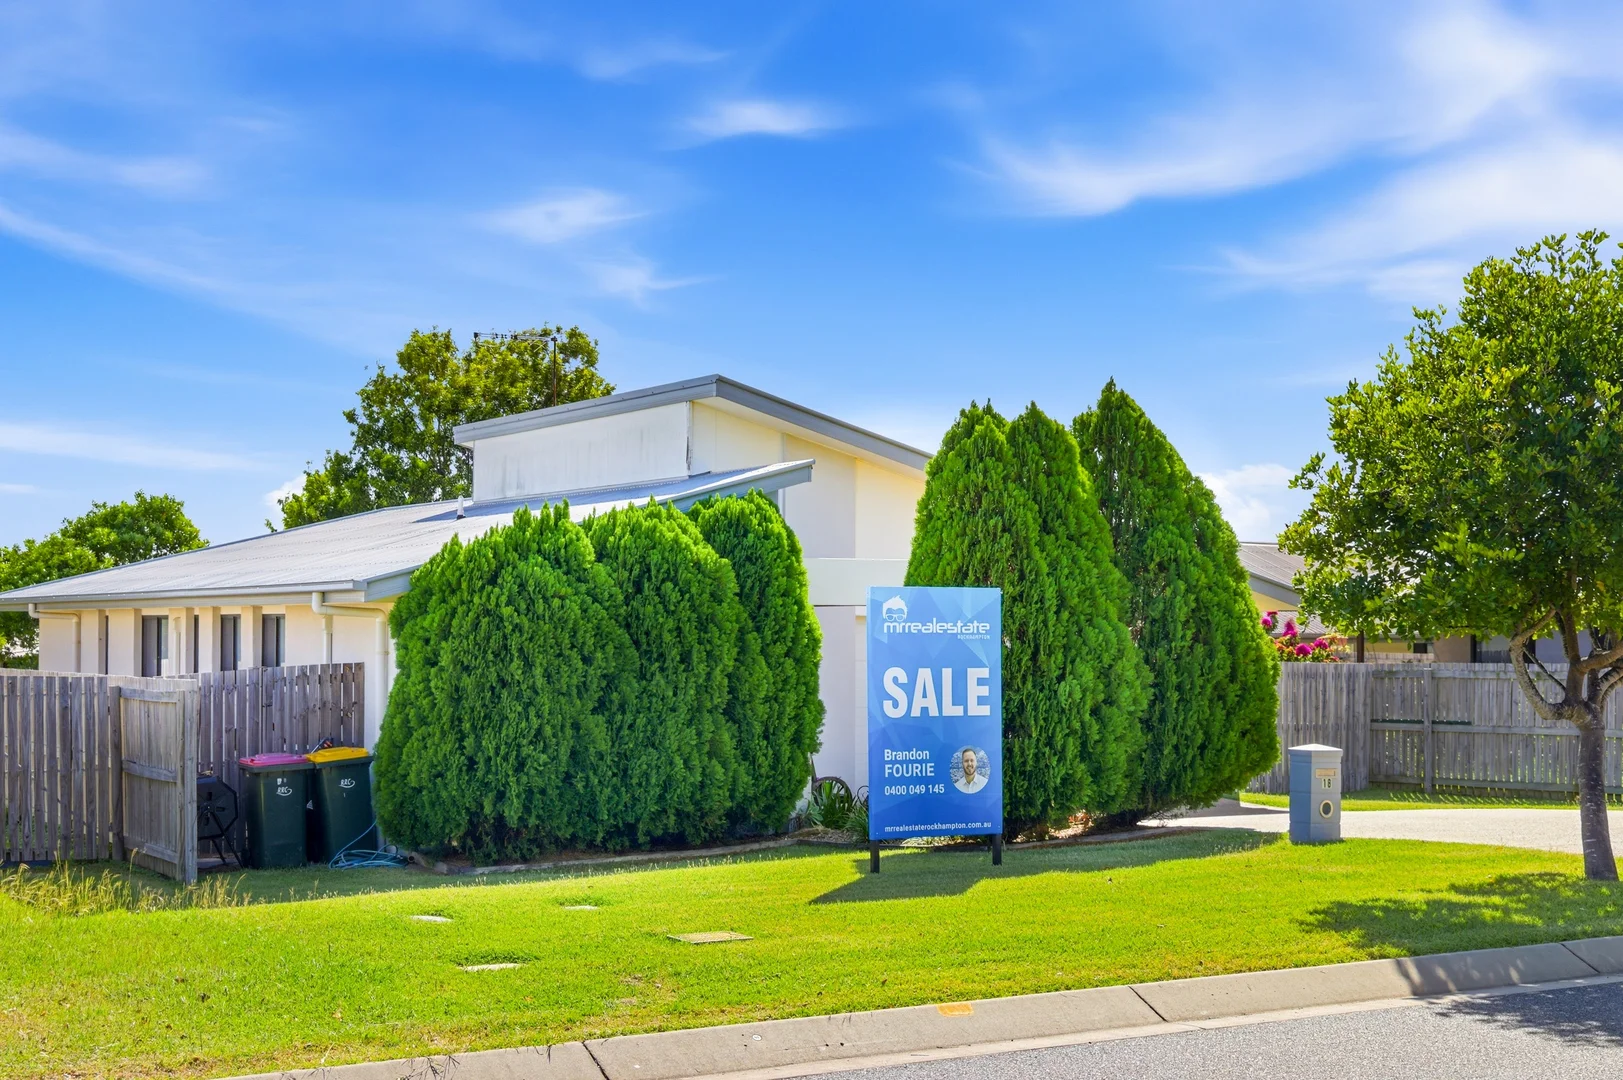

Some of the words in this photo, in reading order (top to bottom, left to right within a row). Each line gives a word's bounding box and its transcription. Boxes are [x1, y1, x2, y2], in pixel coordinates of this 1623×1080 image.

[883, 617, 990, 634] mrrealestate
[882, 666, 991, 719] SALE
[884, 748, 930, 761] Brandon
[884, 763, 935, 778] FOURIE
[884, 785, 907, 796] 0400
[909, 785, 926, 795] 049
[928, 783, 945, 794] 145
[884, 821, 992, 833] mrrealestaterockhampton.com.au
